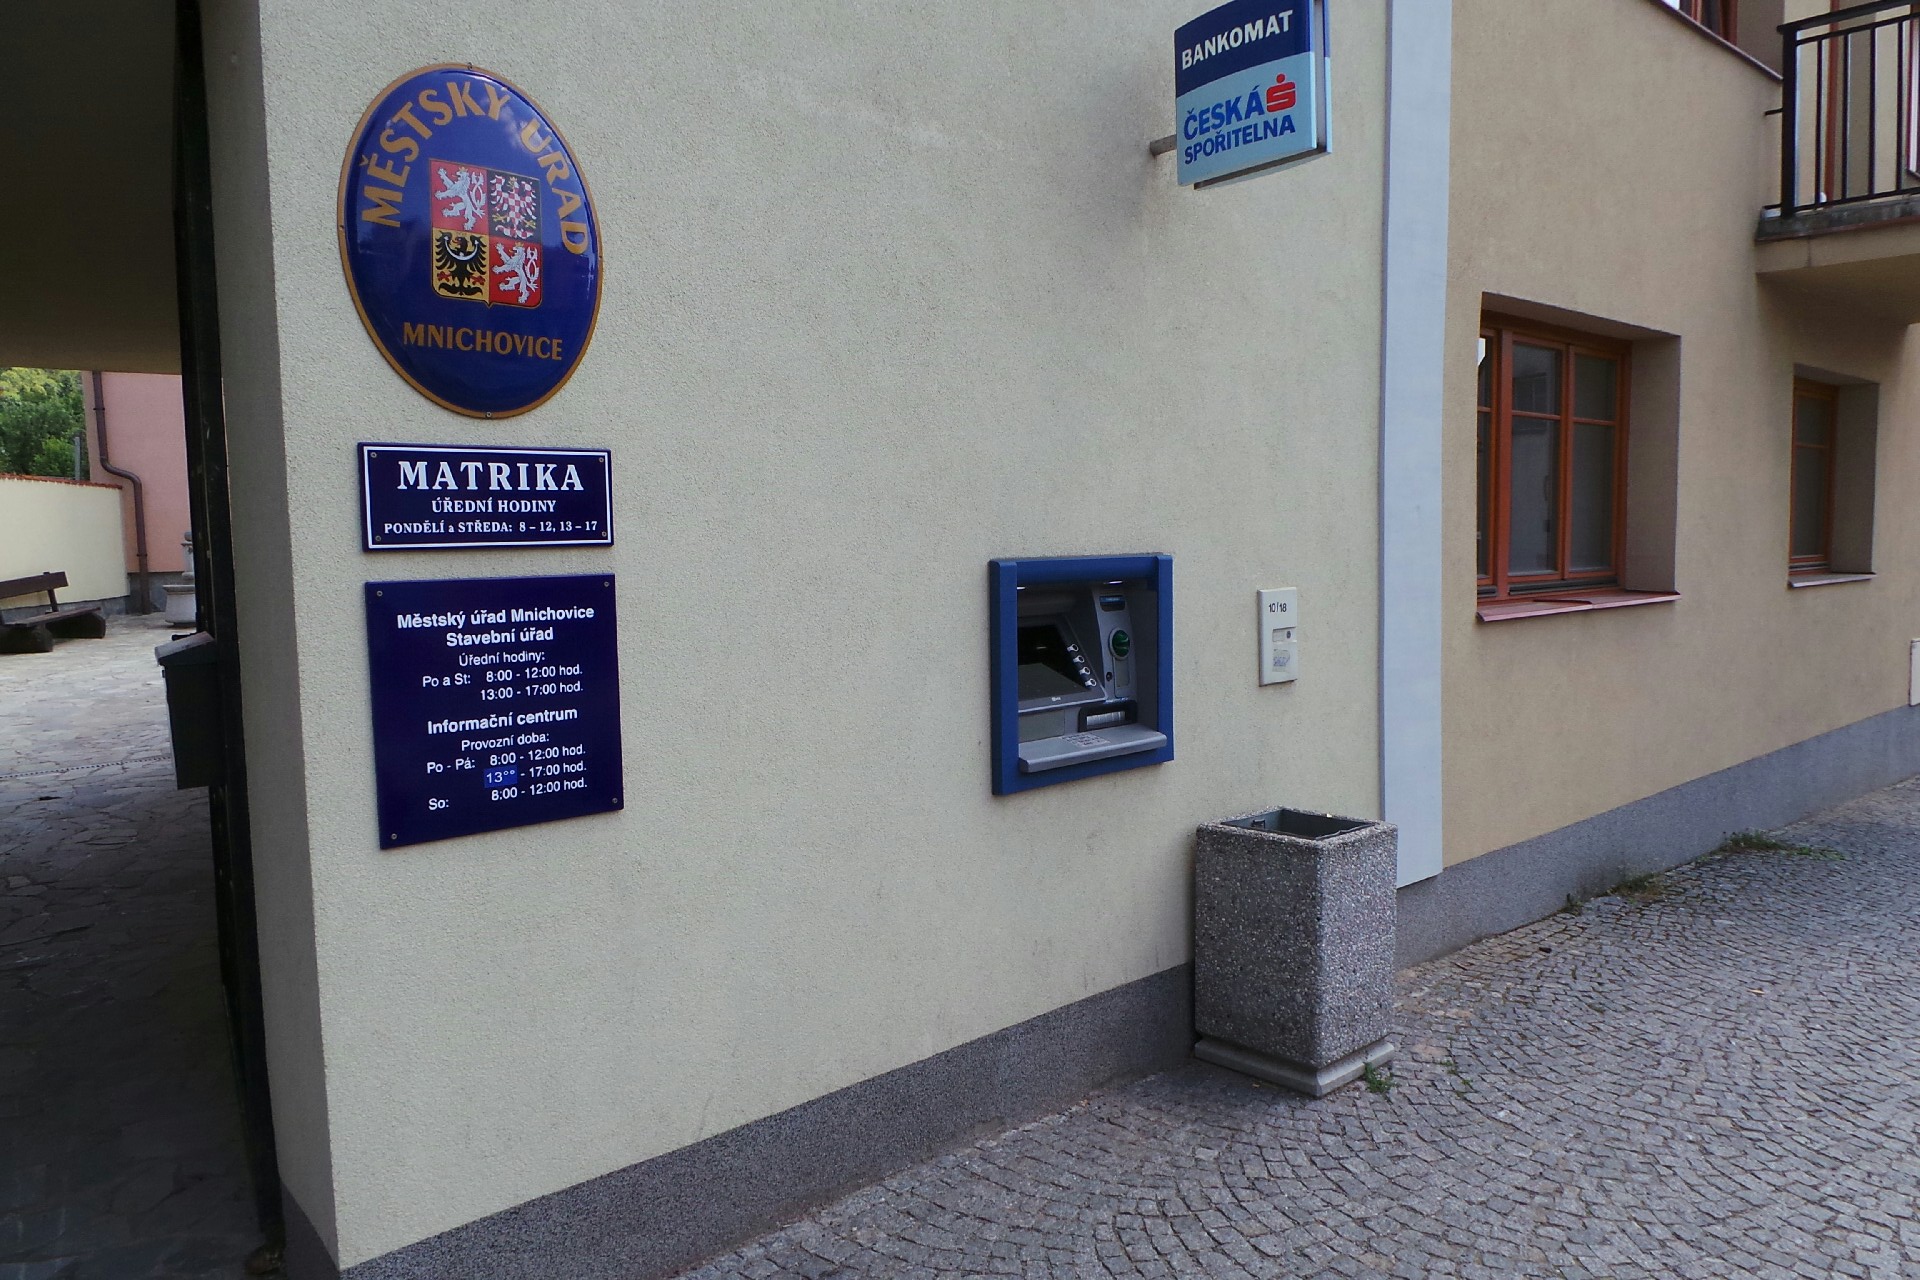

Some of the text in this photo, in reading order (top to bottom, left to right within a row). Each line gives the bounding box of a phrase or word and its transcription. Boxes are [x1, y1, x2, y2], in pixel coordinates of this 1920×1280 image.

[1182, 9, 1293, 71] BANKOMAT
[1183, 84, 1265, 141] ČESKÁ
[1184, 114, 1296, 165] SPOŘITELNA
[402, 321, 563, 361] MNICHOVICE
[396, 460, 584, 491] MATRIKA
[431, 497, 557, 513] ÚŘEDNÍ HODINY
[384, 520, 445, 534] PONDĚLÍ
[449, 523, 455, 533] a
[457, 518, 513, 533] STŘEDA:
[519, 521, 526, 532] 8
[540, 521, 556, 533] 12,
[560, 521, 572, 532] 13
[585, 520, 597, 531] 17
[397, 605, 595, 629] Městský úřad Mnichovice
[446, 626, 553, 647] Stavební úřad
[458, 651, 545, 667] Úřední hodiny:
[422, 675, 439, 687] Po
[443, 677, 450, 686] a
[454, 672, 471, 685] St:
[486, 669, 513, 683] 8:00
[525, 666, 556, 679] 12:00
[559, 663, 583, 676] hod.
[480, 687, 513, 701] 13:00
[525, 683, 556, 696] 17:00
[559, 680, 583, 693] hod.
[427, 707, 578, 734] Informační centrum
[461, 731, 550, 751] Provozní doba:
[427, 762, 443, 773] Po
[455, 758, 475, 770] Pá:
[490, 753, 516, 766] 8:00
[528, 747, 559, 762] 12:00
[562, 744, 585, 757] hod.
[529, 764, 560, 778] 17:00
[562, 760, 587, 774] hod.
[428, 798, 449, 811] So:
[491, 787, 518, 801] 8:00
[530, 781, 561, 795] 12:00
[563, 777, 588, 790] hod.
